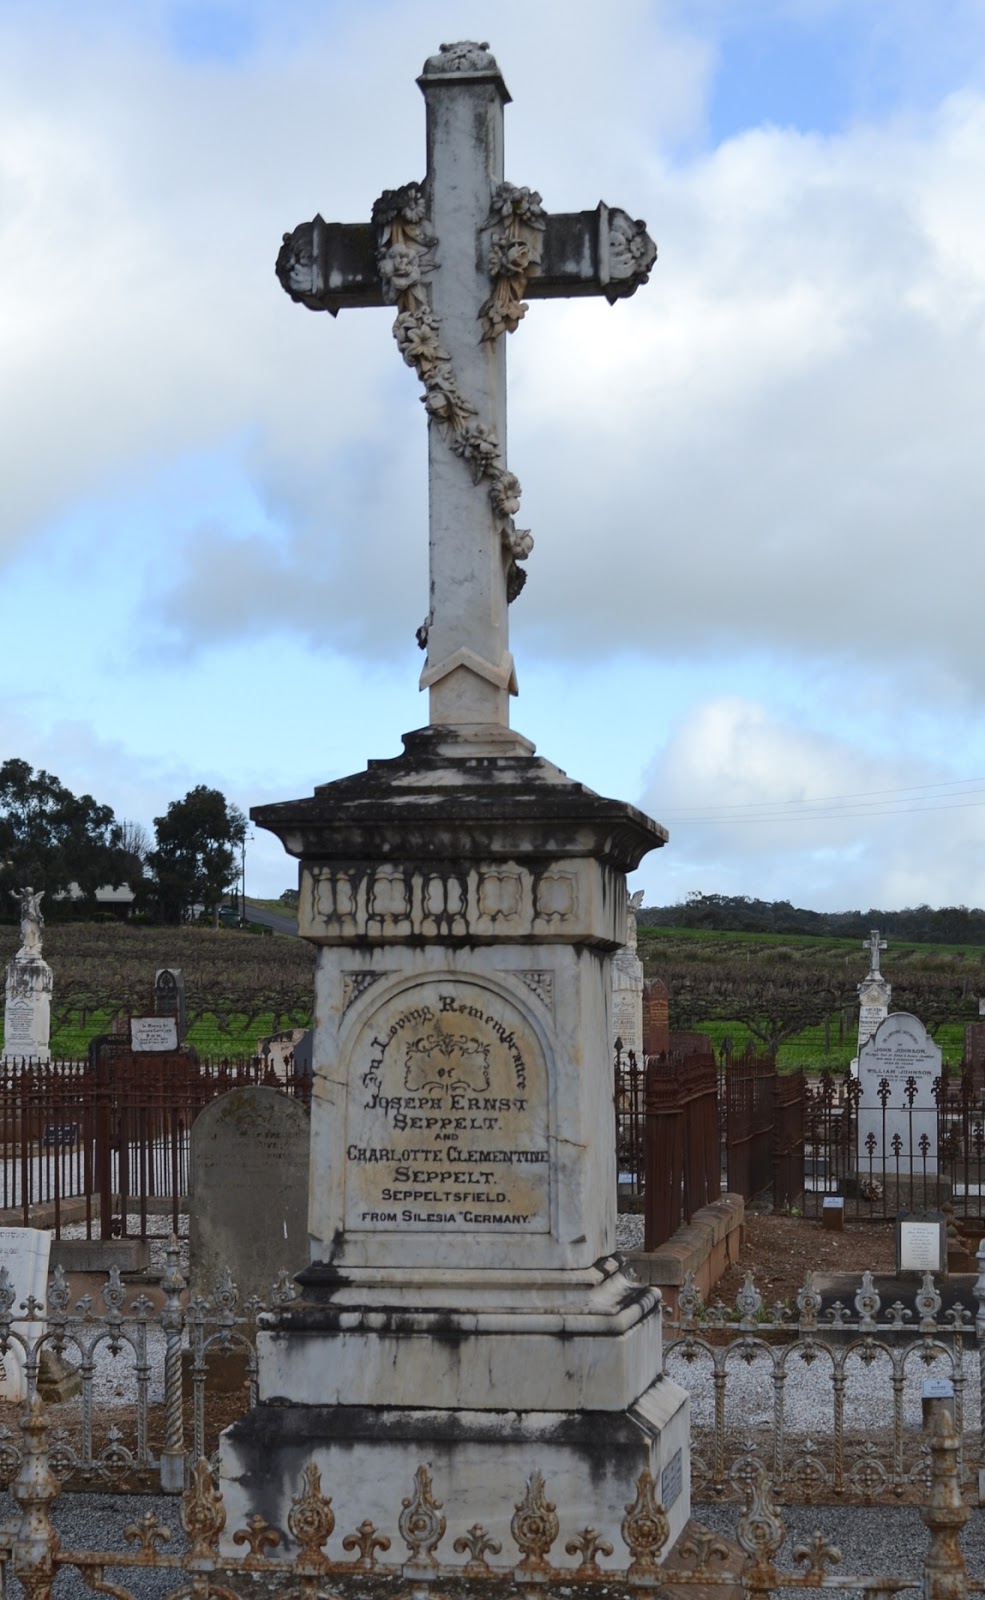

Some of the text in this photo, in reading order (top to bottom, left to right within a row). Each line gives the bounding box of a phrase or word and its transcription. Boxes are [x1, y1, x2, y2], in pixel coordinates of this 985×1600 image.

[370, 1005, 435, 1059] Loving
[438, 994, 527, 1091] Remembrance
[363, 1093, 529, 1111] JOSEPH ERNST
[393, 1113, 503, 1131] SEPPELT.
[434, 1133, 459, 1142] AND
[347, 1144, 550, 1164] CHARLOTTE CLEMENTINE
[393, 1166, 498, 1184] SEPPELT.
[381, 1188, 511, 1203] SEPPELTSFIELD.
[361, 1212, 398, 1222] FROM
[401, 1210, 457, 1223] SILESIA
